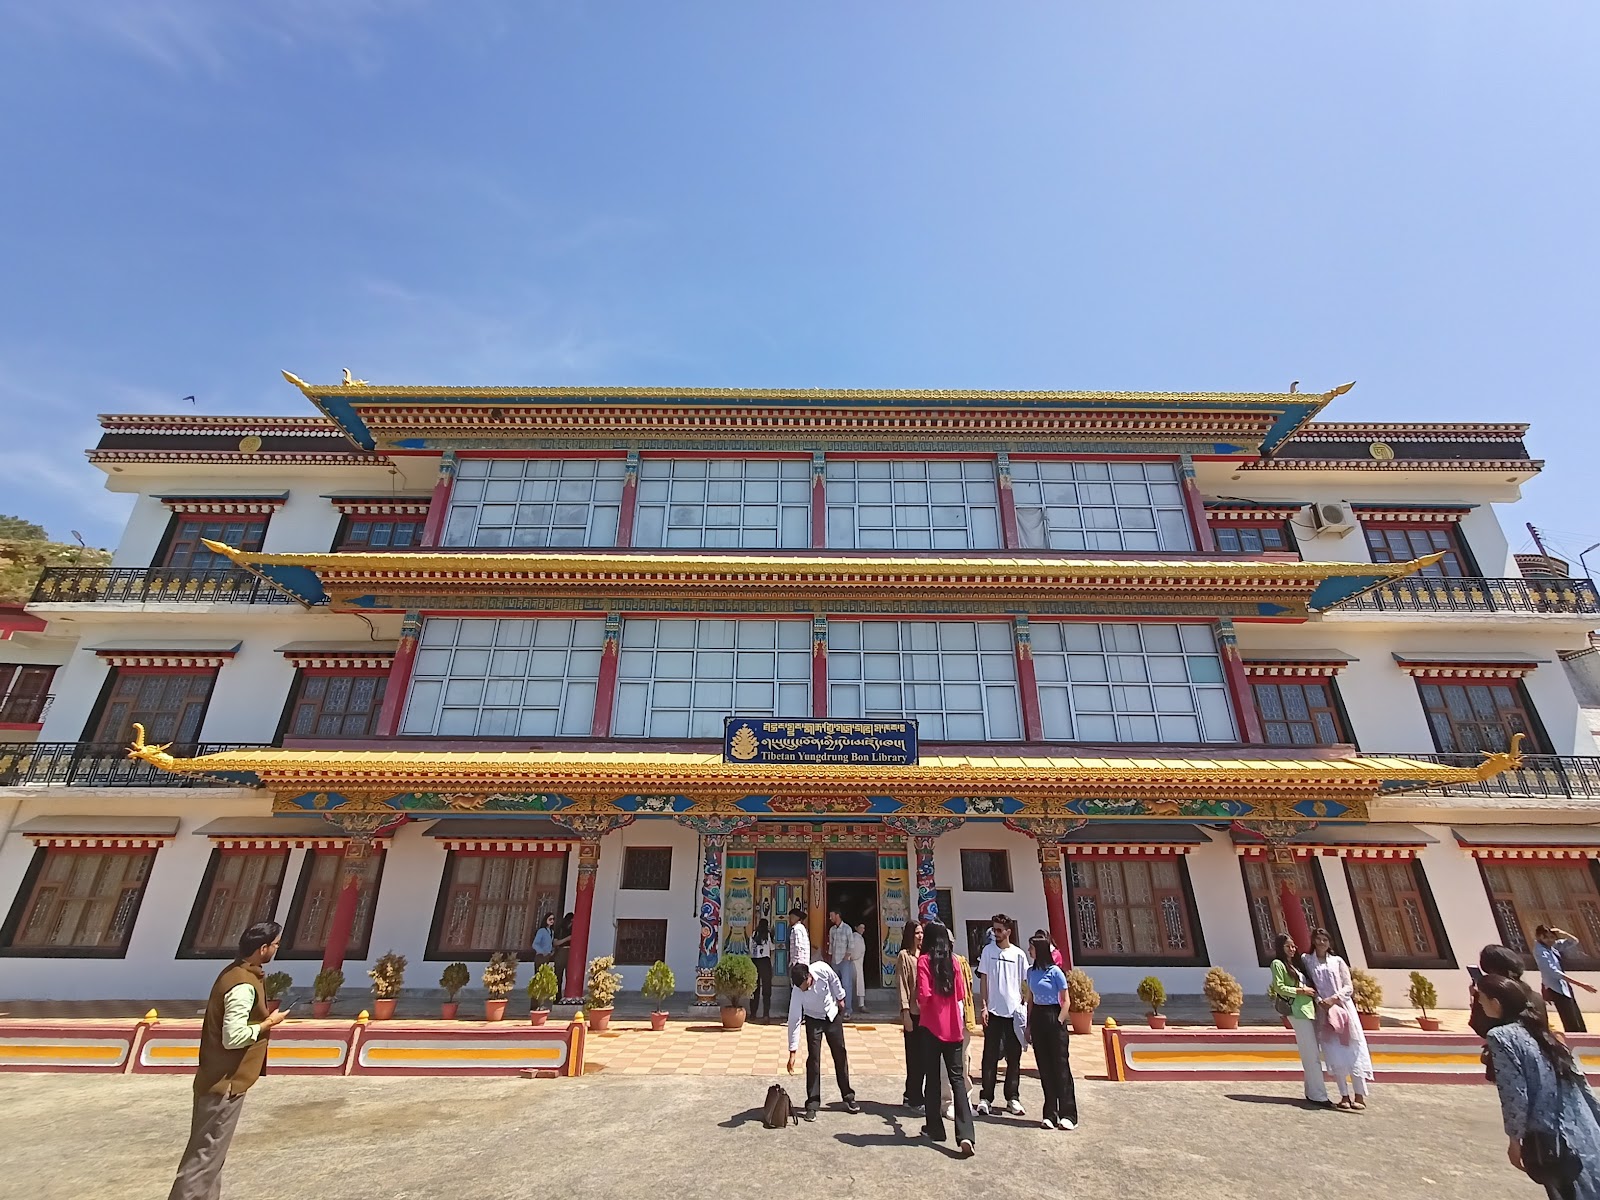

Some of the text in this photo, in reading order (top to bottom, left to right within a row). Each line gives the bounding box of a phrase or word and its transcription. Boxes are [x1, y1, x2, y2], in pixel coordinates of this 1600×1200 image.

[761, 752, 907, 763] Tibetan Yungdrung Bon Library
